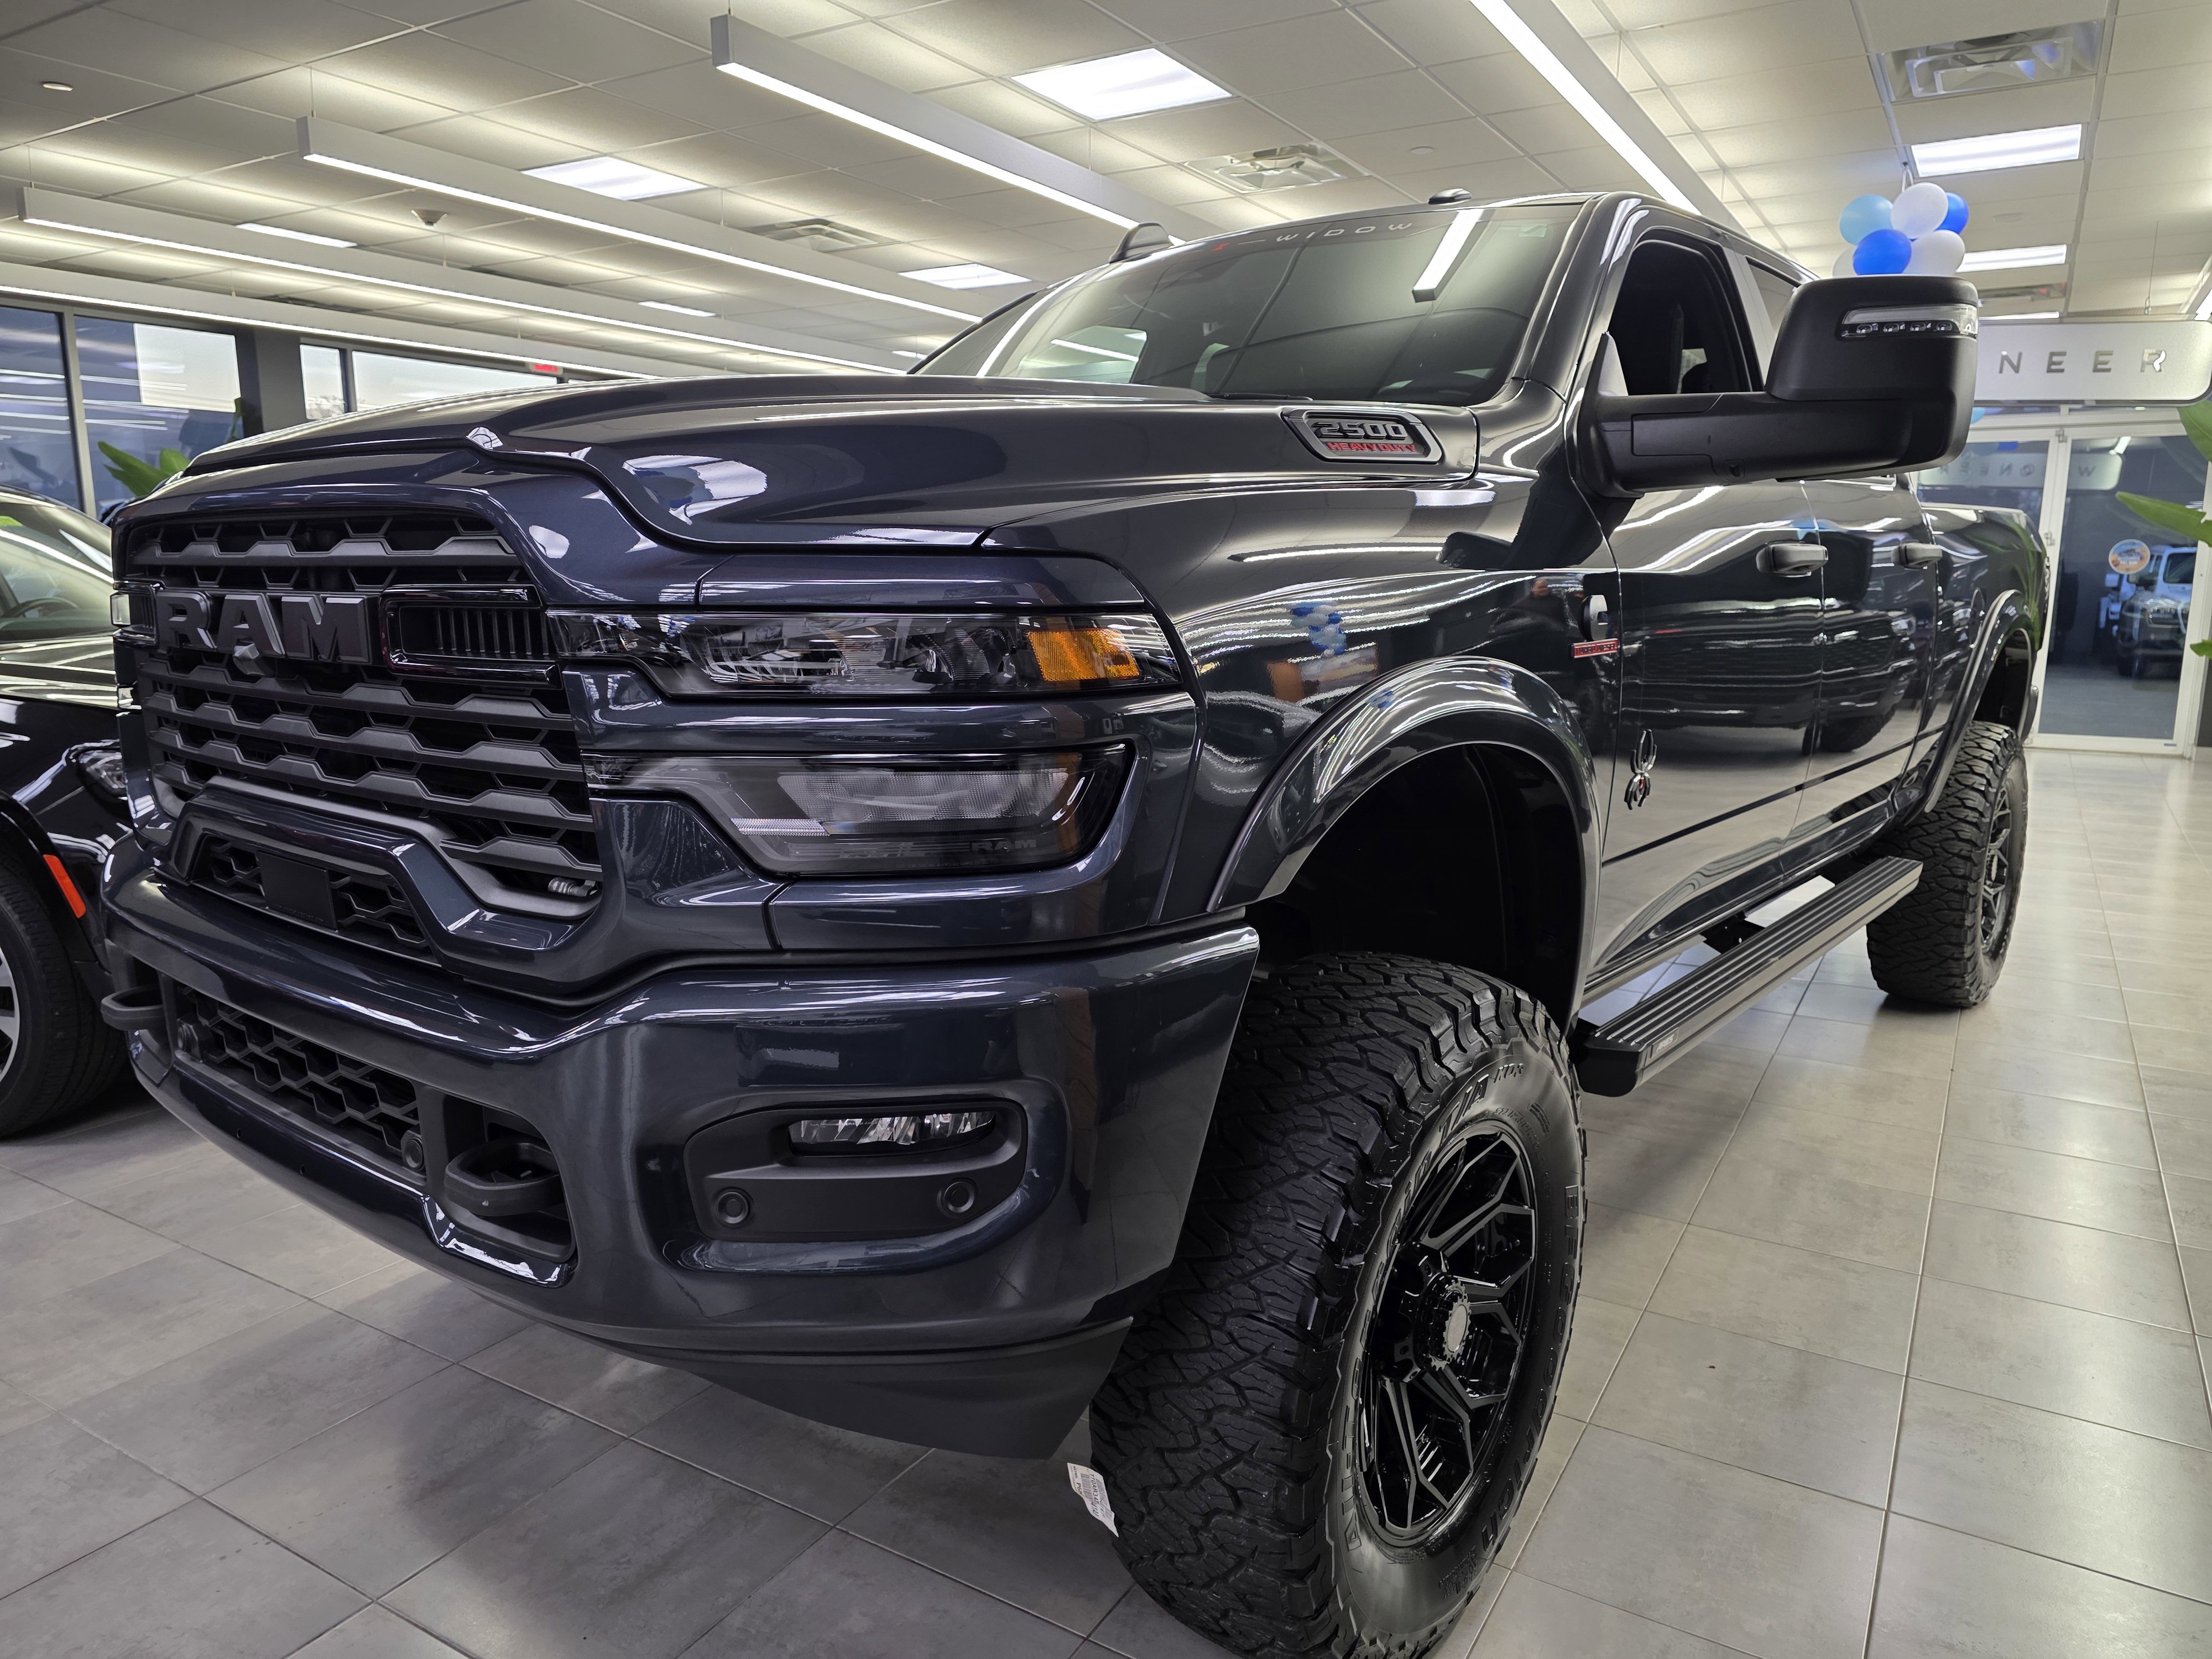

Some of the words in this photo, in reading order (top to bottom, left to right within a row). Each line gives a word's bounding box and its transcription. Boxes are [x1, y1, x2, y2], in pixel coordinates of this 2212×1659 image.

[1276, 222, 1413, 242] WIDOW
[1312, 421, 1408, 440] 2500
[1327, 442, 1377, 451] HEAVY
[1378, 444, 1416, 452] DUTY
[156, 591, 370, 664] RAM
[972, 839, 1037, 852] RAM
